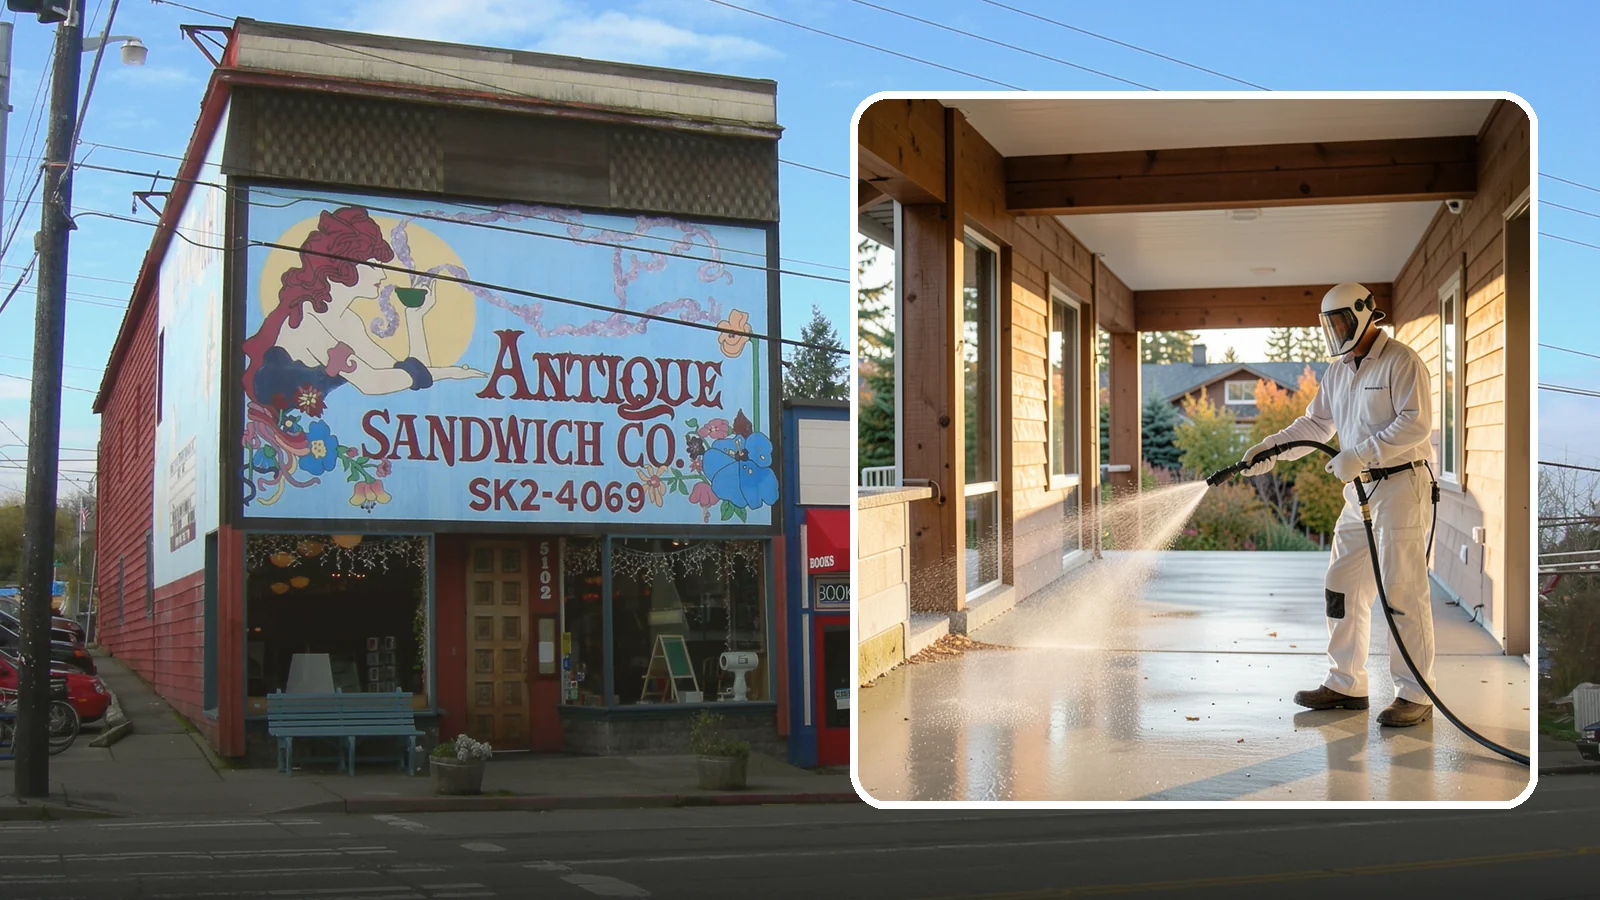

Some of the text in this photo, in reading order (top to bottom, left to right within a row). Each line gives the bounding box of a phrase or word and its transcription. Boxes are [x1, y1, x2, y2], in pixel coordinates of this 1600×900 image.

[476, 329, 723, 421] ANTIQUE
[361, 408, 685, 469] SANDWICH CO.
[469, 477, 645, 513] SK2-4069
[540, 541, 551, 599] 5102
[809, 555, 834, 568] BOOKS
